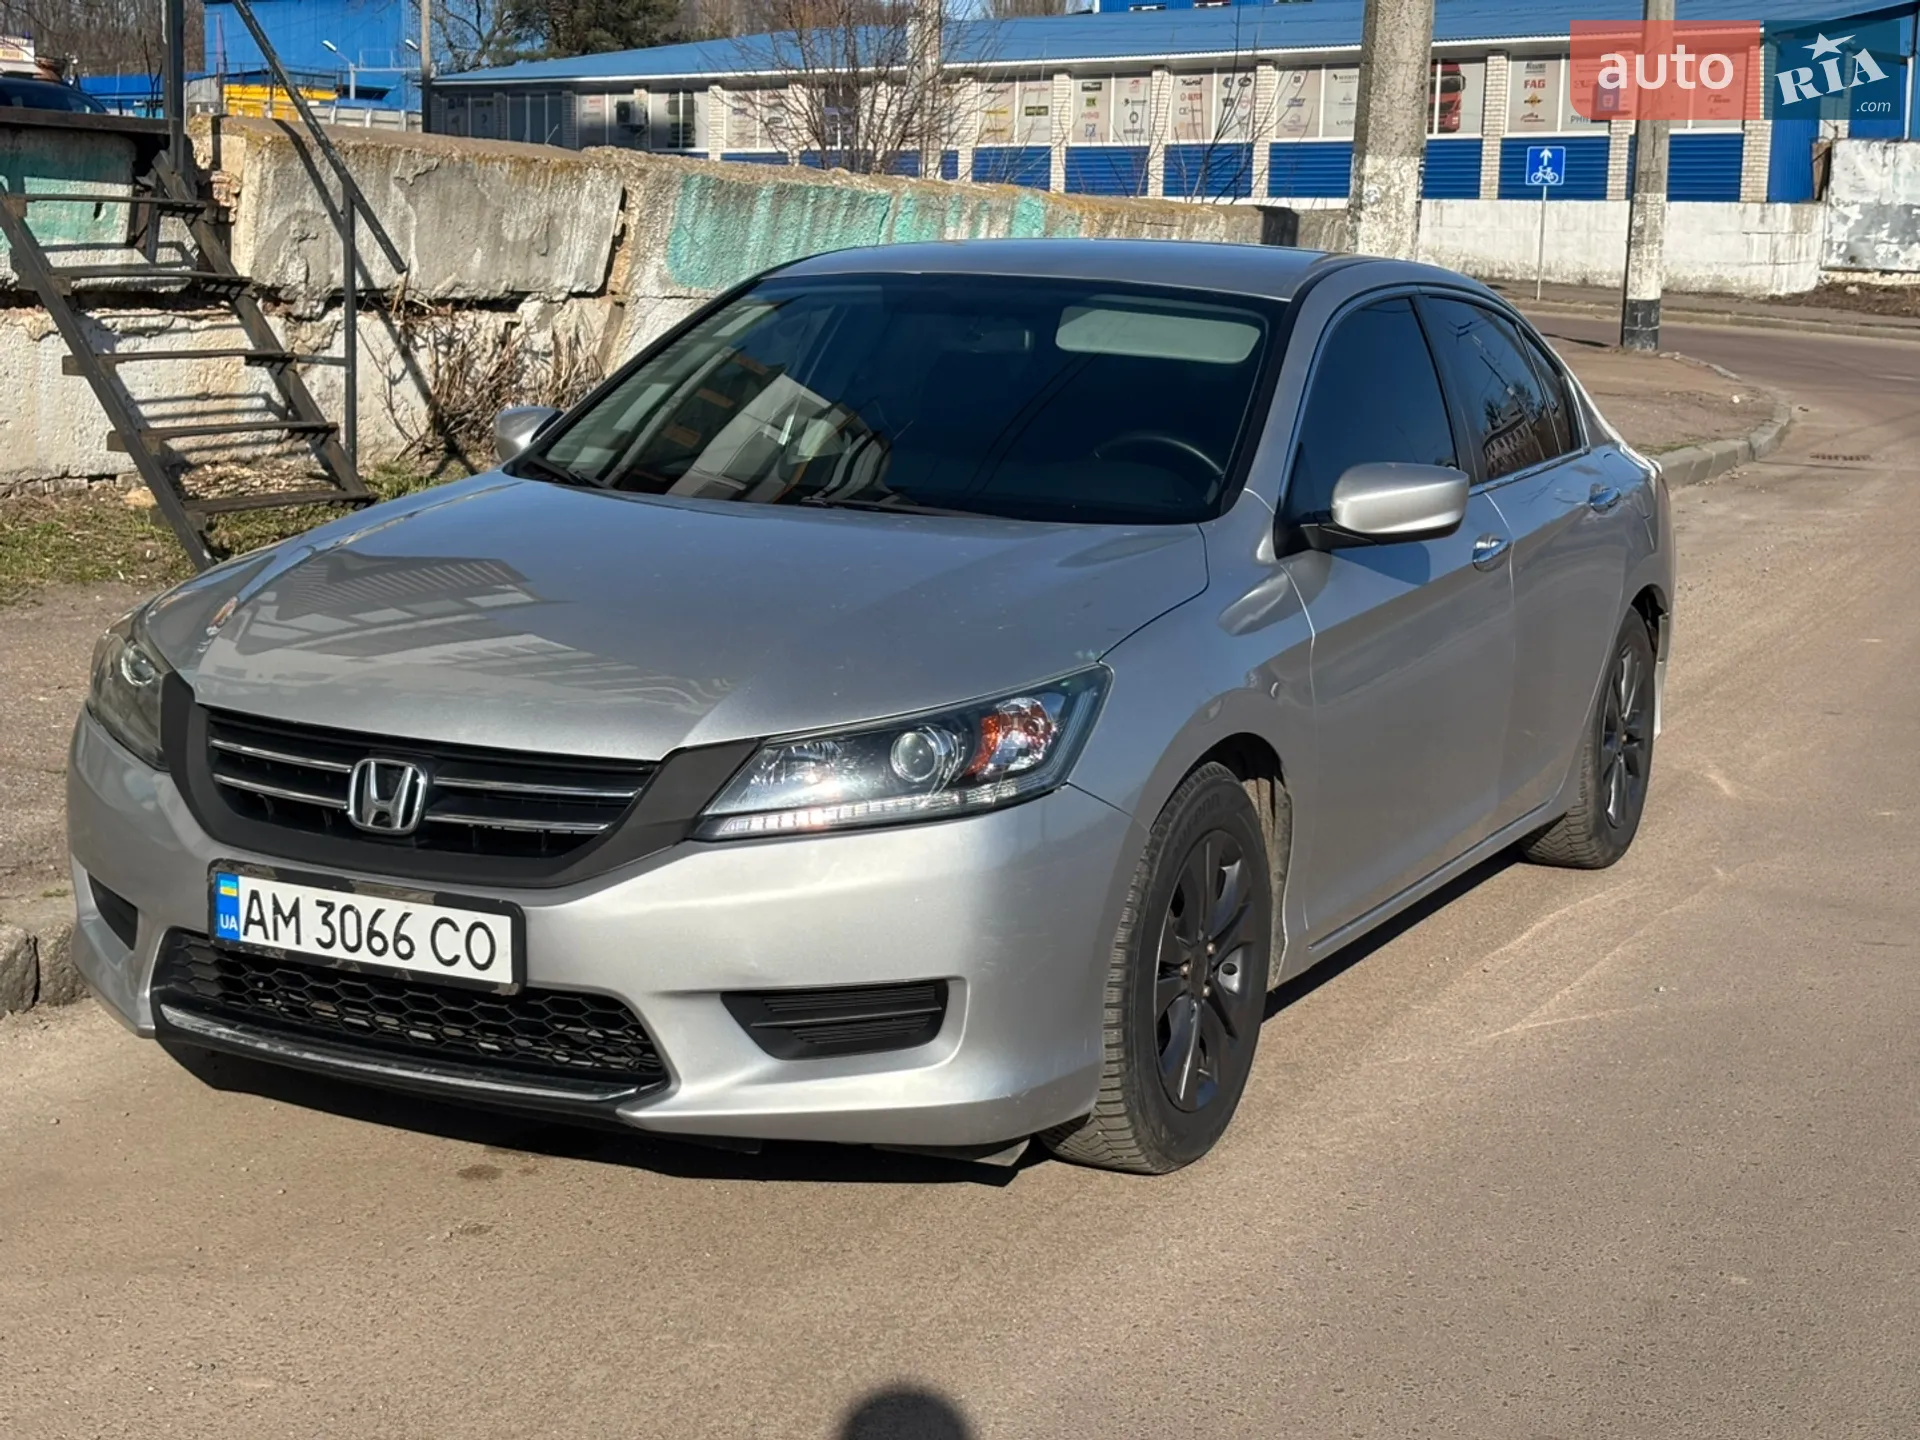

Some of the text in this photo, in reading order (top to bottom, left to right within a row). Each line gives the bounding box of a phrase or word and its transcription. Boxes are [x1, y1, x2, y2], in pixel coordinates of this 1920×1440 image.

[1523, 78, 1546, 89] FAG
[220, 913, 238, 931] UA
[242, 889, 496, 971] AM 3066 CO
